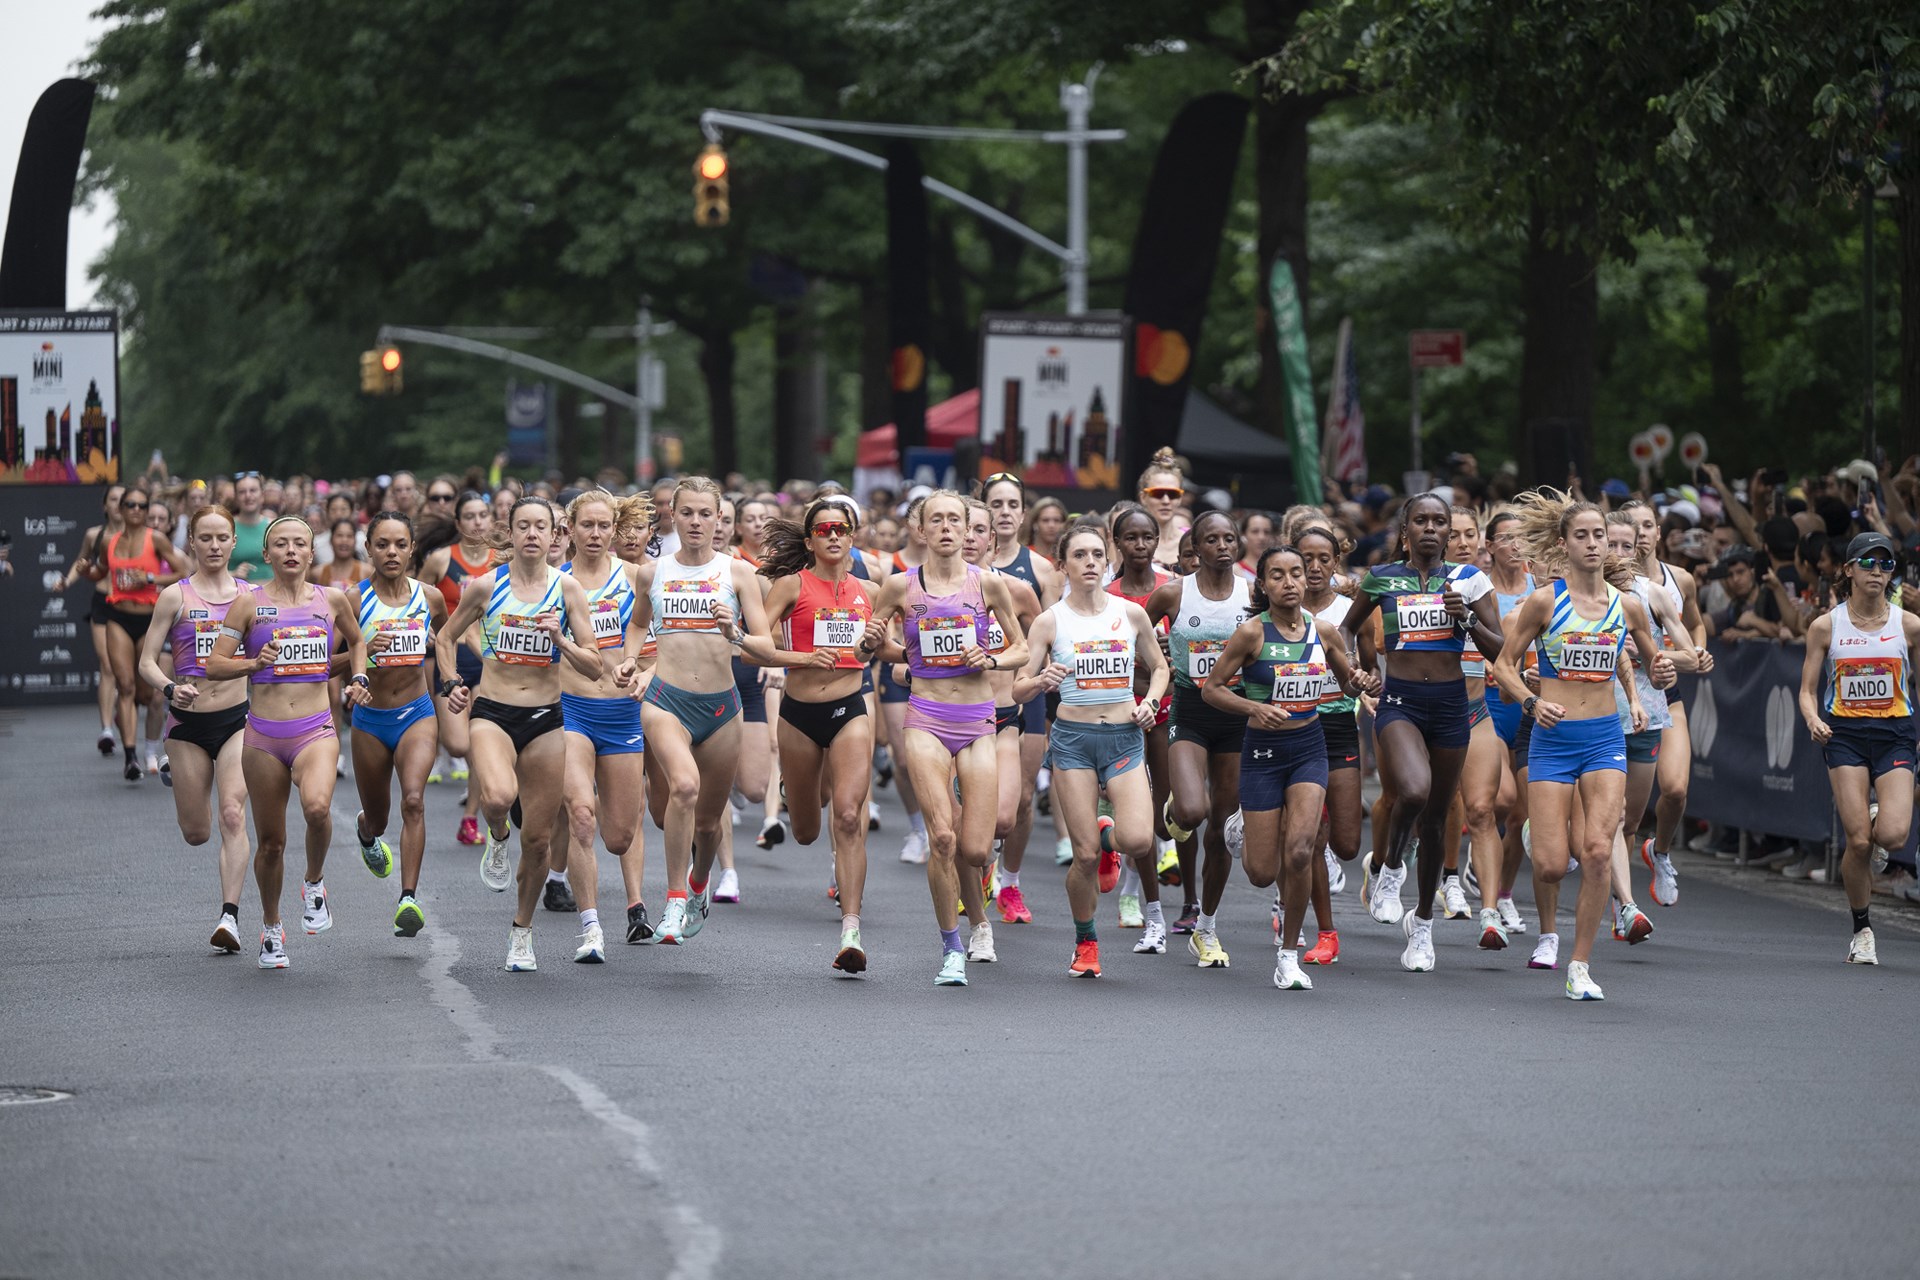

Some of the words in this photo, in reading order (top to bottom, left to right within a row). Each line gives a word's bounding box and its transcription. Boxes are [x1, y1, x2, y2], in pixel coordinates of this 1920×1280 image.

[28, 318, 65, 330] START
[74, 317, 111, 330] START
[33, 358, 63, 379] MINI
[826, 622, 855, 633] RIVERA
[499, 631, 551, 653] INFELD
[828, 633, 853, 644] WOOD
[933, 634, 963, 653] ROE
[1076, 657, 1129, 675] HURLEY
[1563, 649, 1615, 669] VESTRI
[1275, 680, 1323, 699] KELATI
[1847, 680, 1887, 698] ANDO
